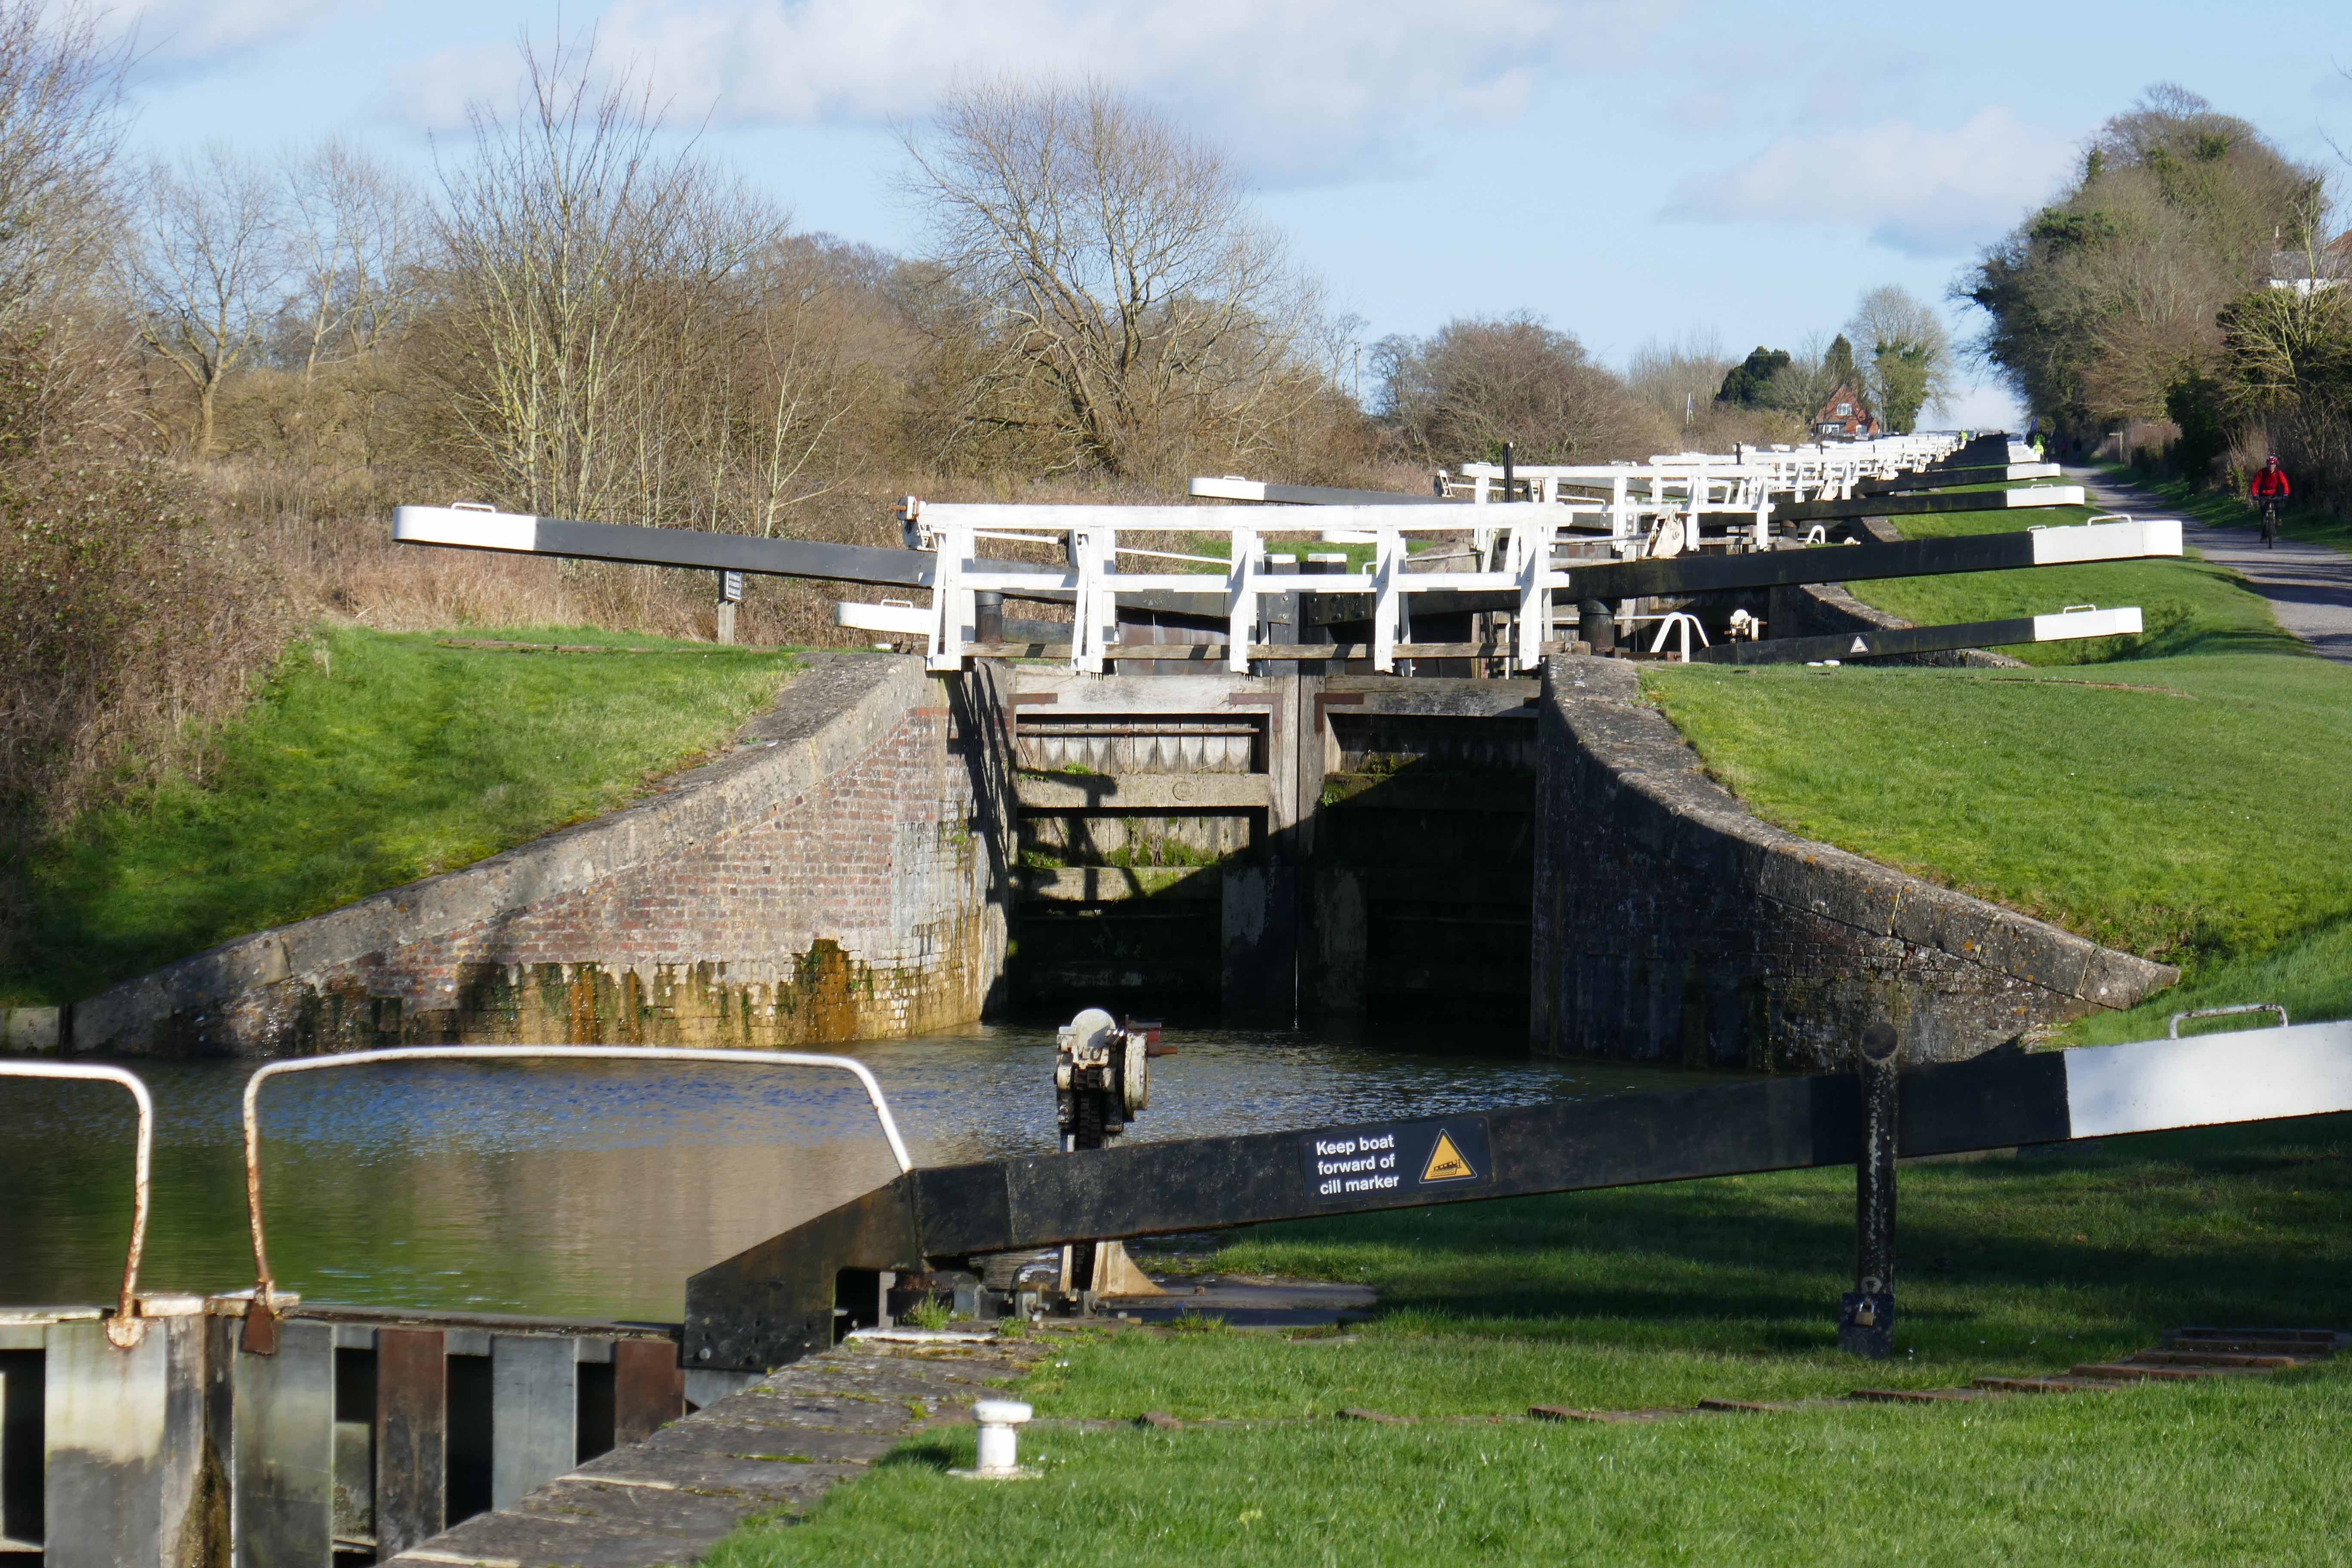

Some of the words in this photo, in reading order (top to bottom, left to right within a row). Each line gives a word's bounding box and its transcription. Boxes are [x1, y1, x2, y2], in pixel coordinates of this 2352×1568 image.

[1317, 1140, 1356, 1155] Keep
[1359, 1134, 1394, 1152] boat
[1317, 1155, 1375, 1175] forward
[1380, 1153, 1396, 1168] of
[1320, 1179, 1341, 1195] cill
[1346, 1175, 1400, 1192] marker
